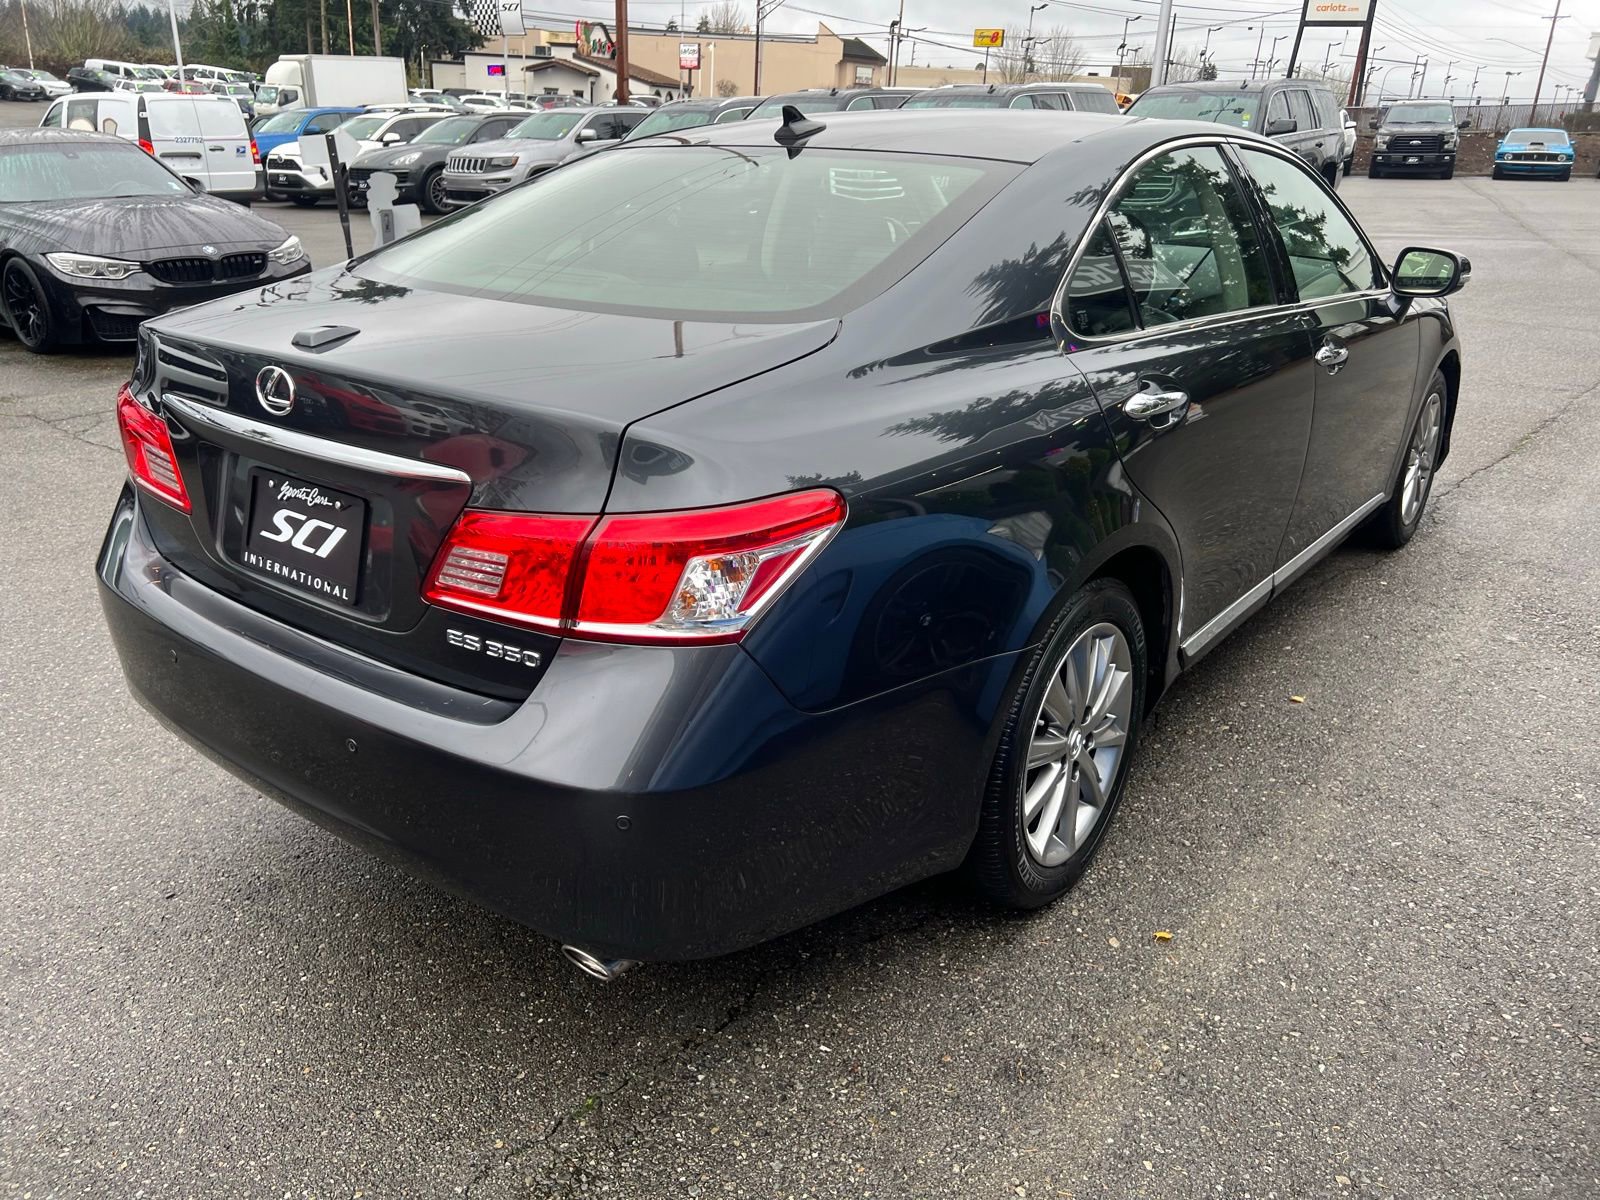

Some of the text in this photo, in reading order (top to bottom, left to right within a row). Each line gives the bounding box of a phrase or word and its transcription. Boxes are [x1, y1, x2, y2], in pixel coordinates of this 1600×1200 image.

[502, 3, 519, 11] SCI
[1316, 3, 1359, 12] carlotz.com
[991, 32, 999, 43] 8
[277, 481, 333, 506] Sports Cars
[259, 508, 348, 559] SCI
[244, 551, 349, 600] INTERNATIONAL
[446, 628, 541, 667] ES 350
